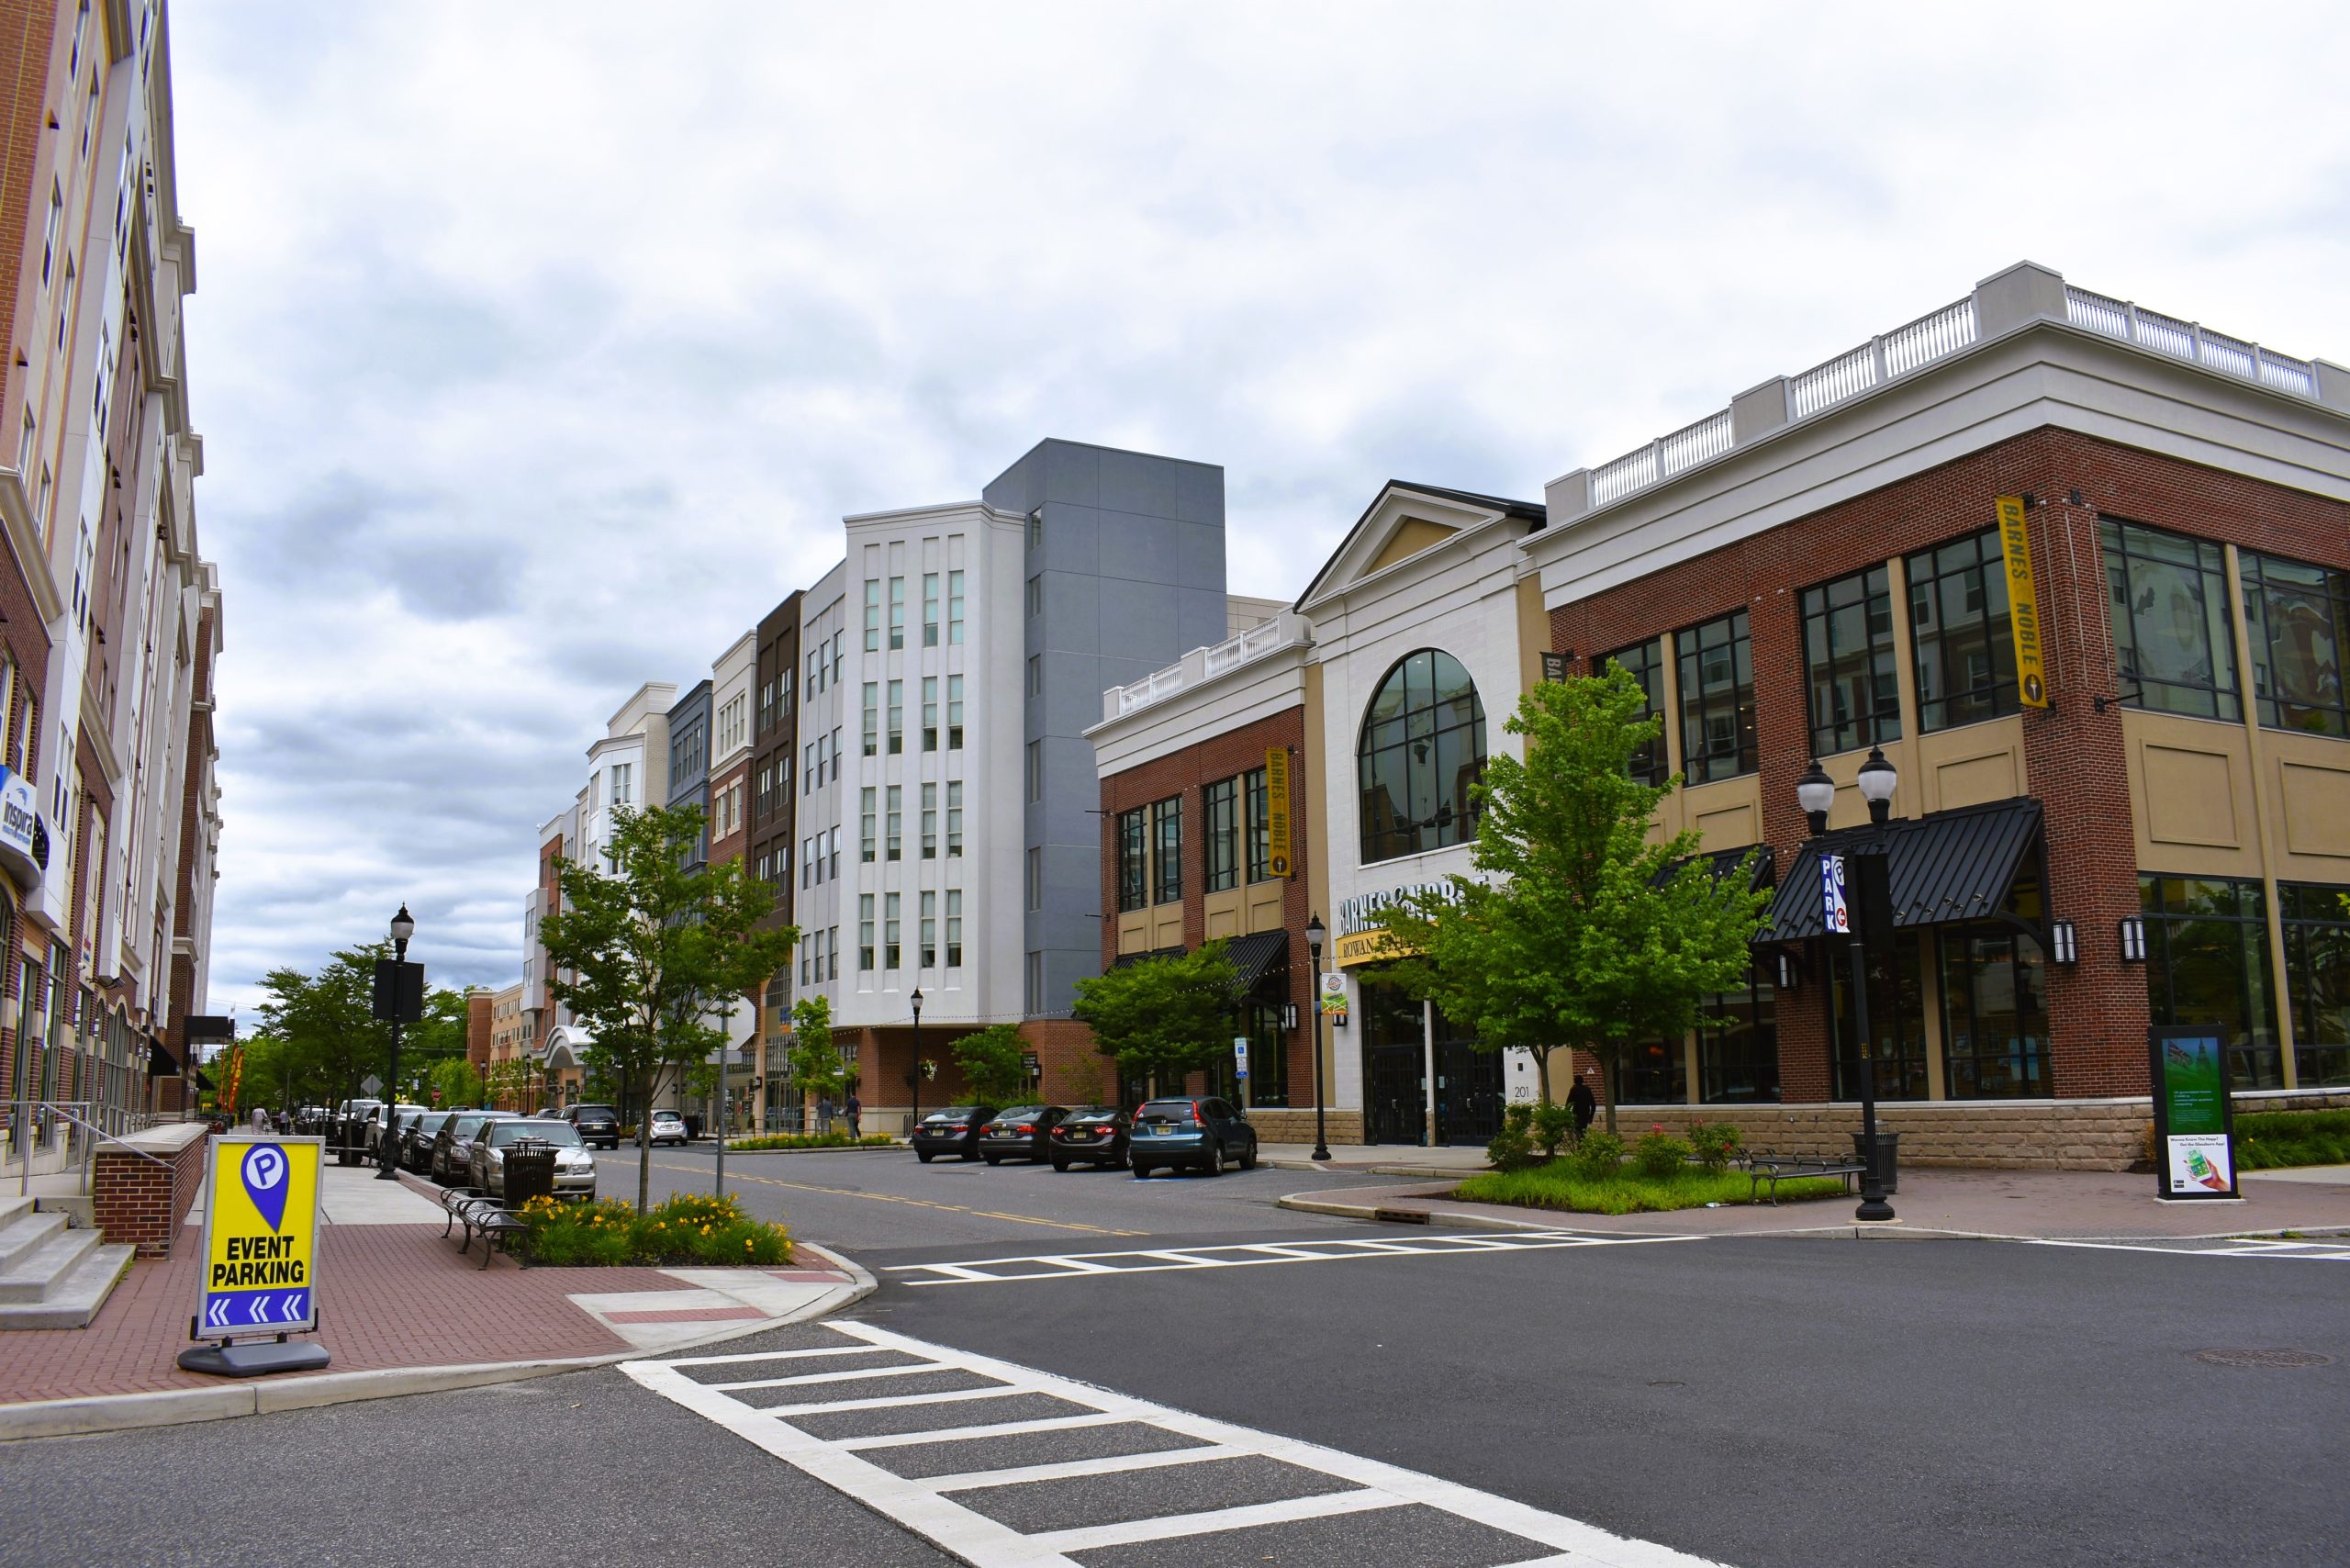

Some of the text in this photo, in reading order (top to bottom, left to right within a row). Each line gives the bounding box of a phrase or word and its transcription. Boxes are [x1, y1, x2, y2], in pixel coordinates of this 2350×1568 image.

[2003, 504, 2028, 580] BARNES
[2016, 602, 2038, 666] NOBLE
[1270, 753, 1285, 800] BARNES
[4, 792, 33, 838] inspira
[1272, 813, 1286, 851] NOBLE
[1822, 859, 1835, 930] PARK
[1343, 937, 1375, 958] ROWAN
[1515, 1086, 1529, 1098] 201
[254, 1153, 275, 1186] P
[227, 1236, 295, 1260] EVENT
[212, 1260, 304, 1287] PARKING
